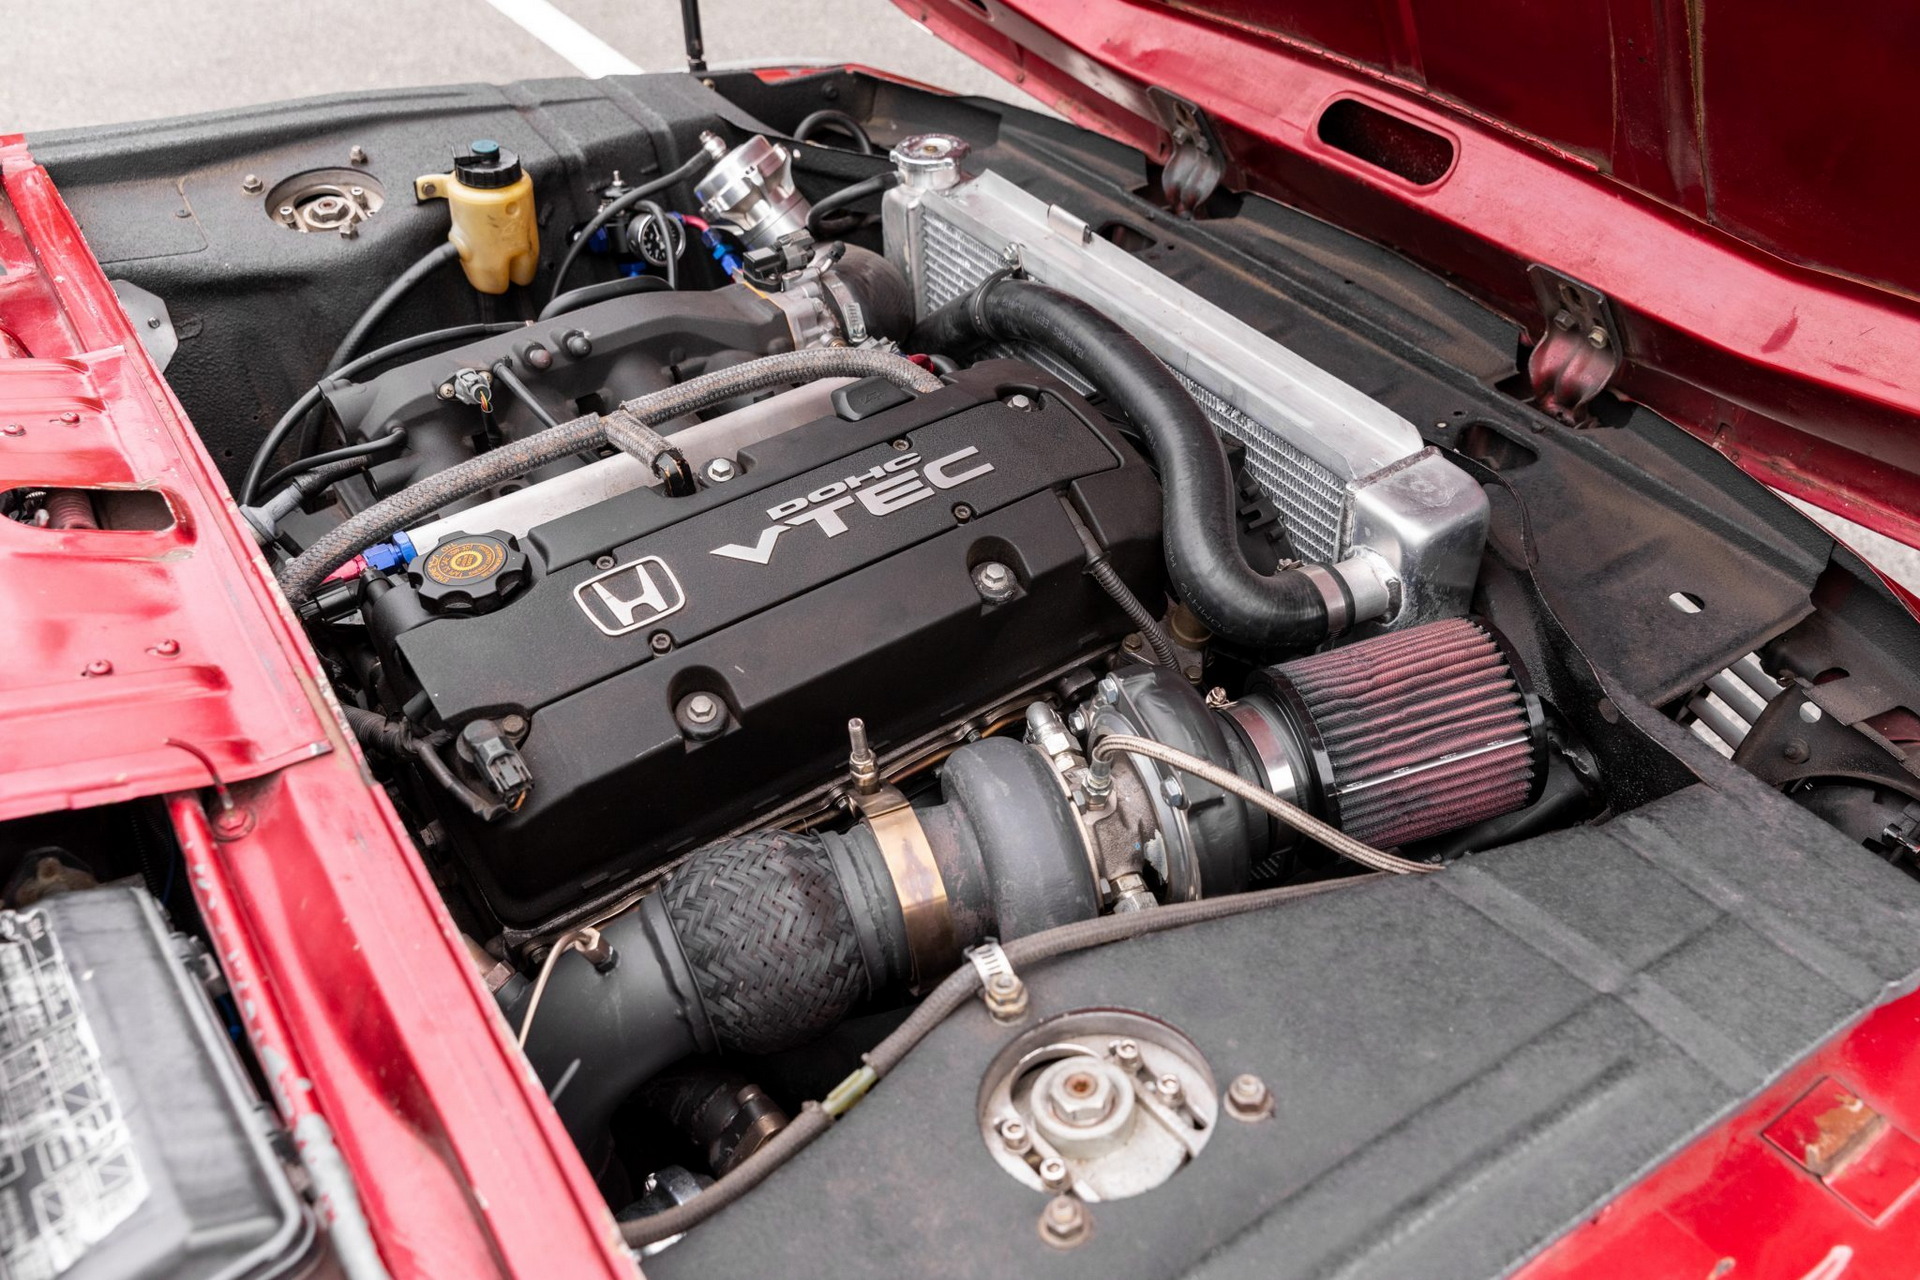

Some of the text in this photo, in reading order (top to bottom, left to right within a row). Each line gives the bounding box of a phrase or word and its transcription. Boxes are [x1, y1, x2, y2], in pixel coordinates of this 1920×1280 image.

[709, 445, 995, 565] VTEC
[766, 452, 922, 521] DOHC
[441, 542, 458, 553] OIL
